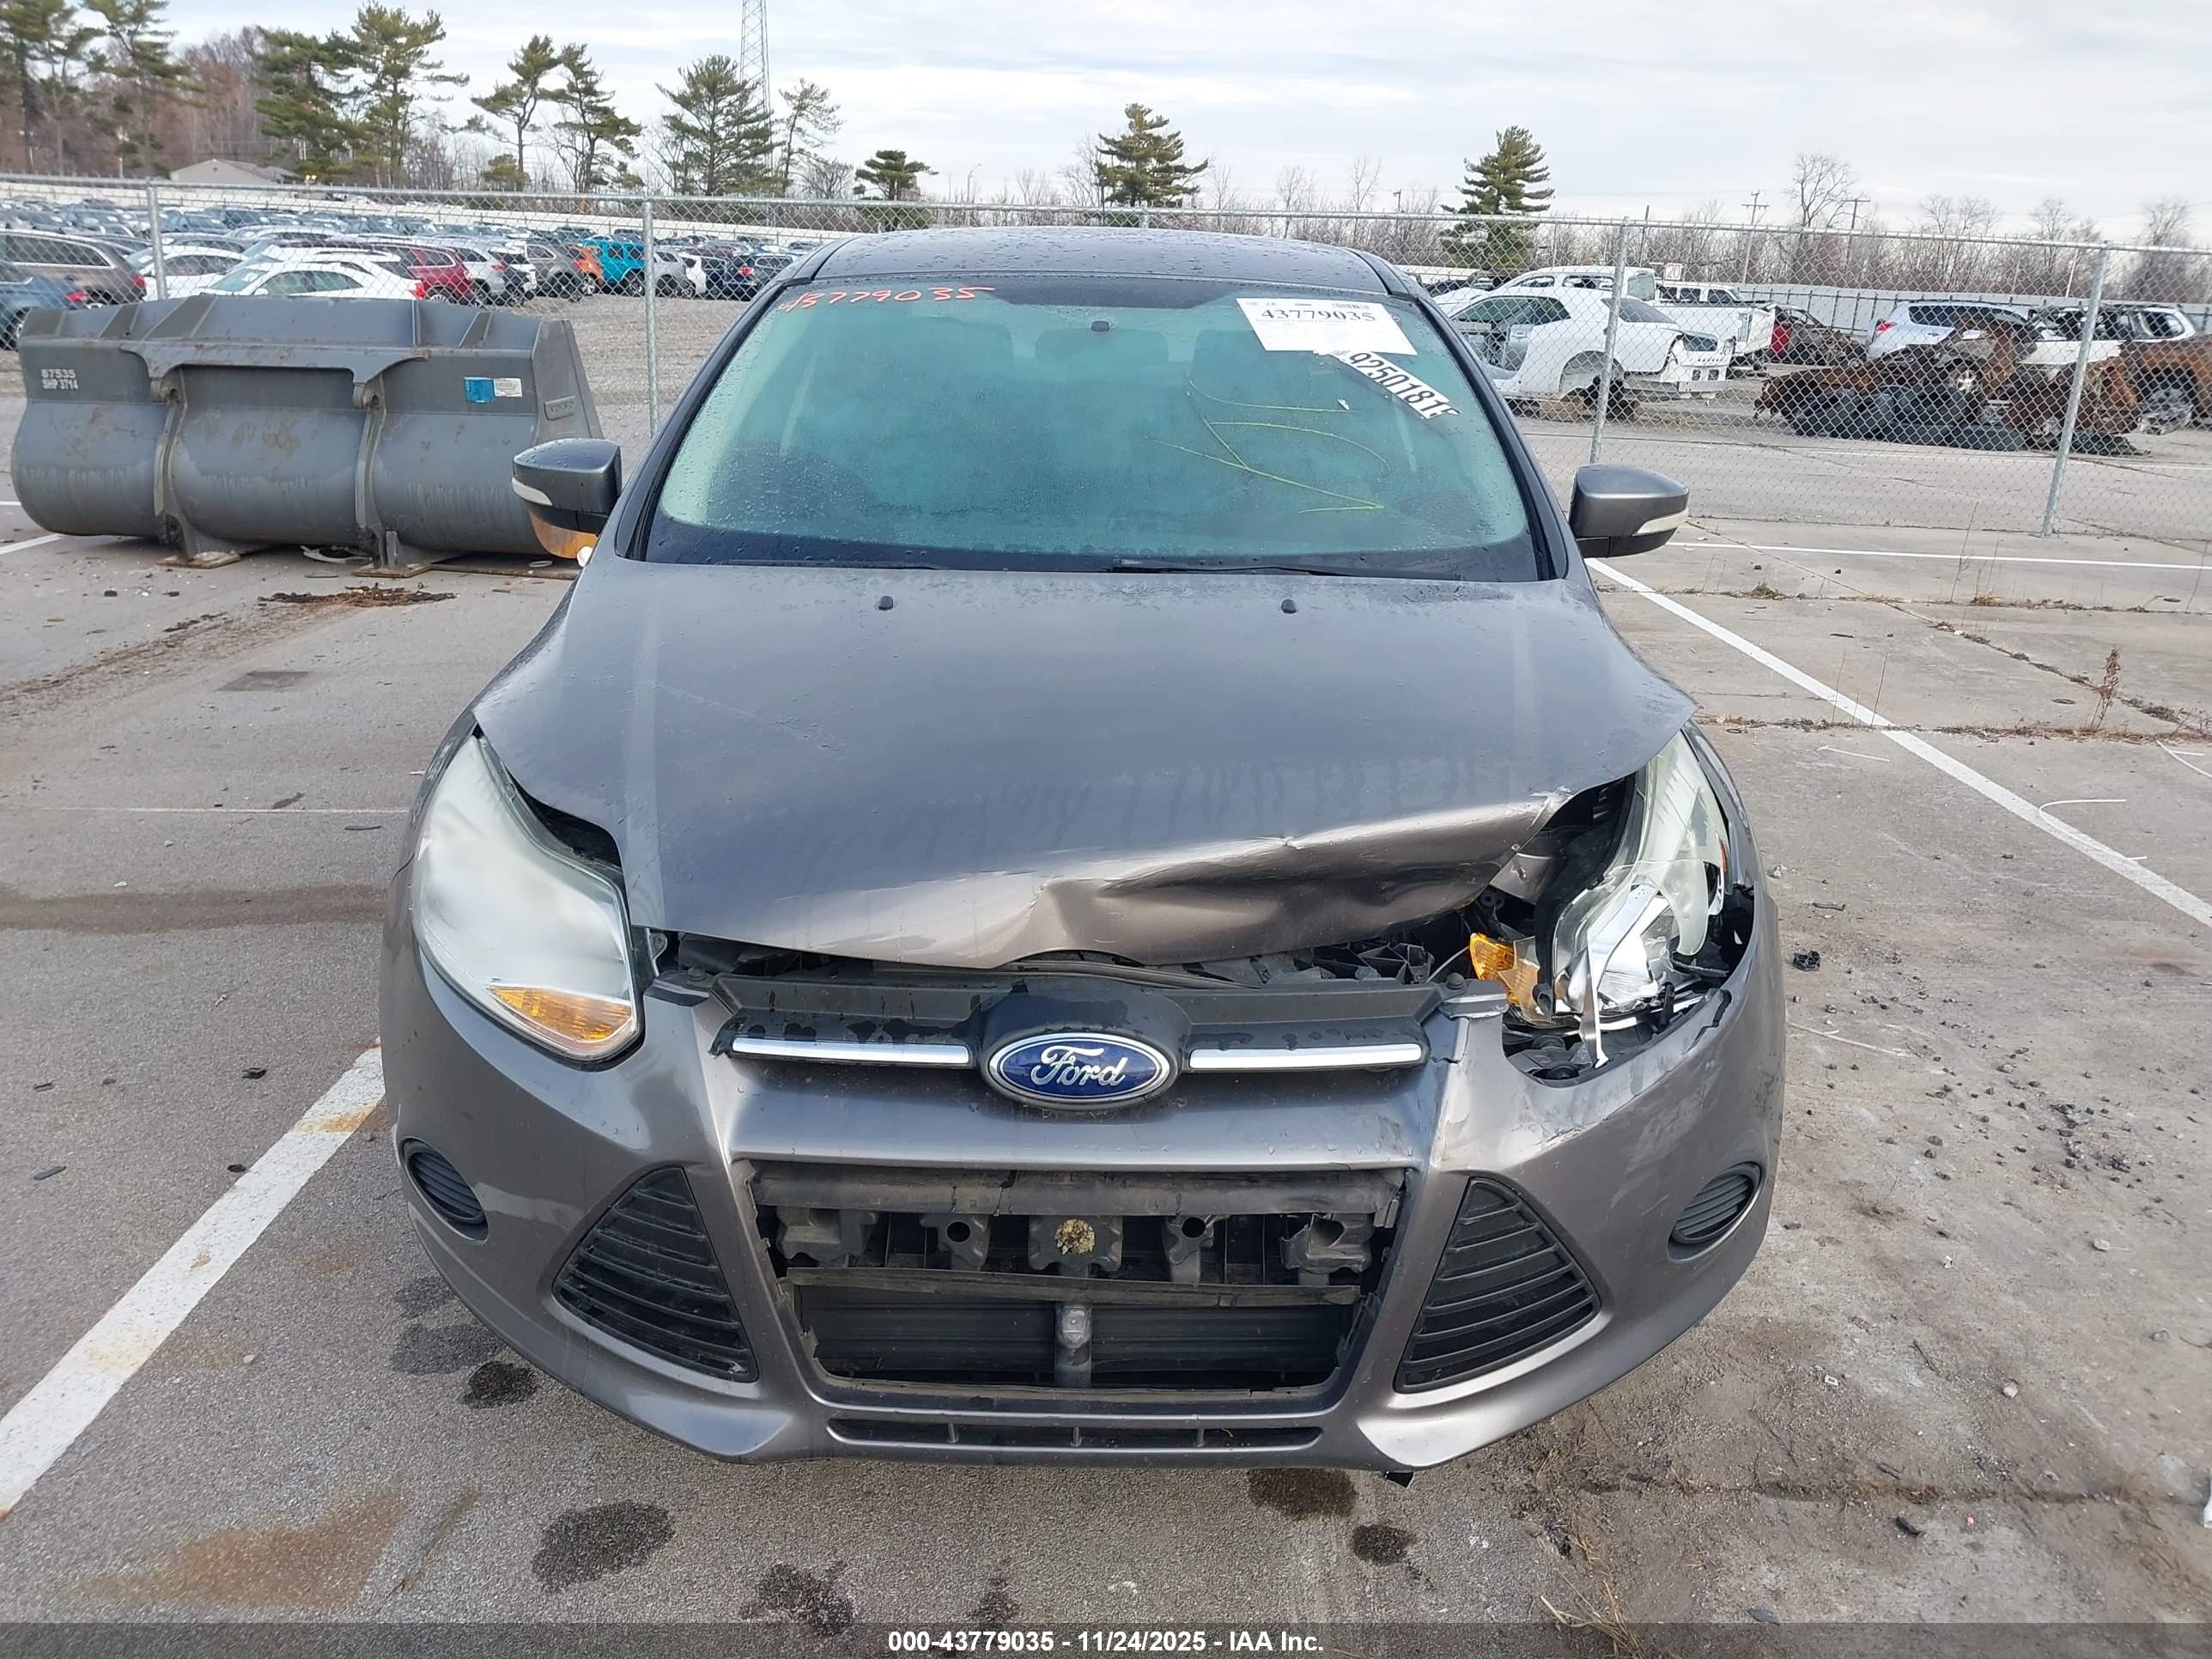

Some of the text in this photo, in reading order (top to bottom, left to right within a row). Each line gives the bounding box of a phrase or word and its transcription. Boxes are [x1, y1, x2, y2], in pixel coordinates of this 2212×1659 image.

[1261, 309, 1376, 322] 43779035
[41, 368, 76, 379] 87535
[1030, 1045, 1128, 1086] Ford
